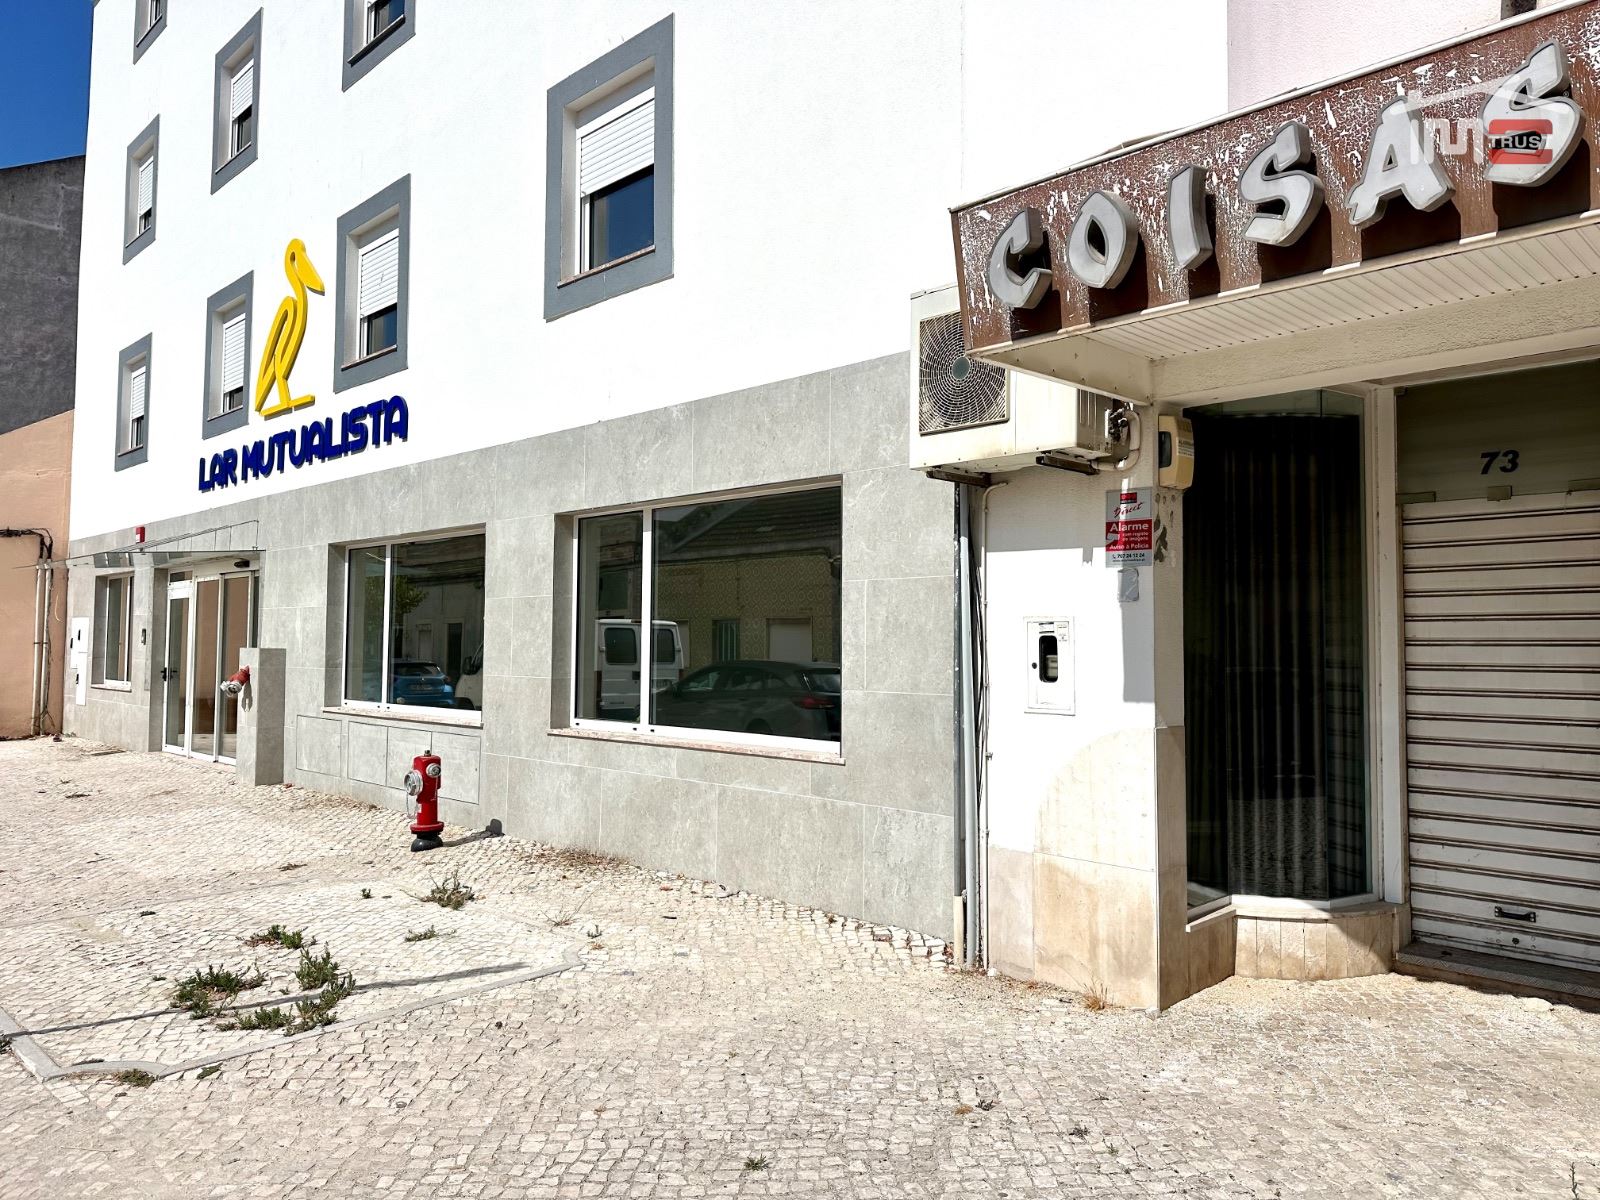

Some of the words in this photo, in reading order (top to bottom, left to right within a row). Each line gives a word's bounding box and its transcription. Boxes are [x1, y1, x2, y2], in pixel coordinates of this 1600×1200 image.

[987, 38, 1586, 309] COISAS
[199, 448, 238, 493] LAR
[241, 395, 409, 484] MUTUALISTA
[1480, 449, 1520, 475] 73
[1110, 522, 1149, 531] Alarme
